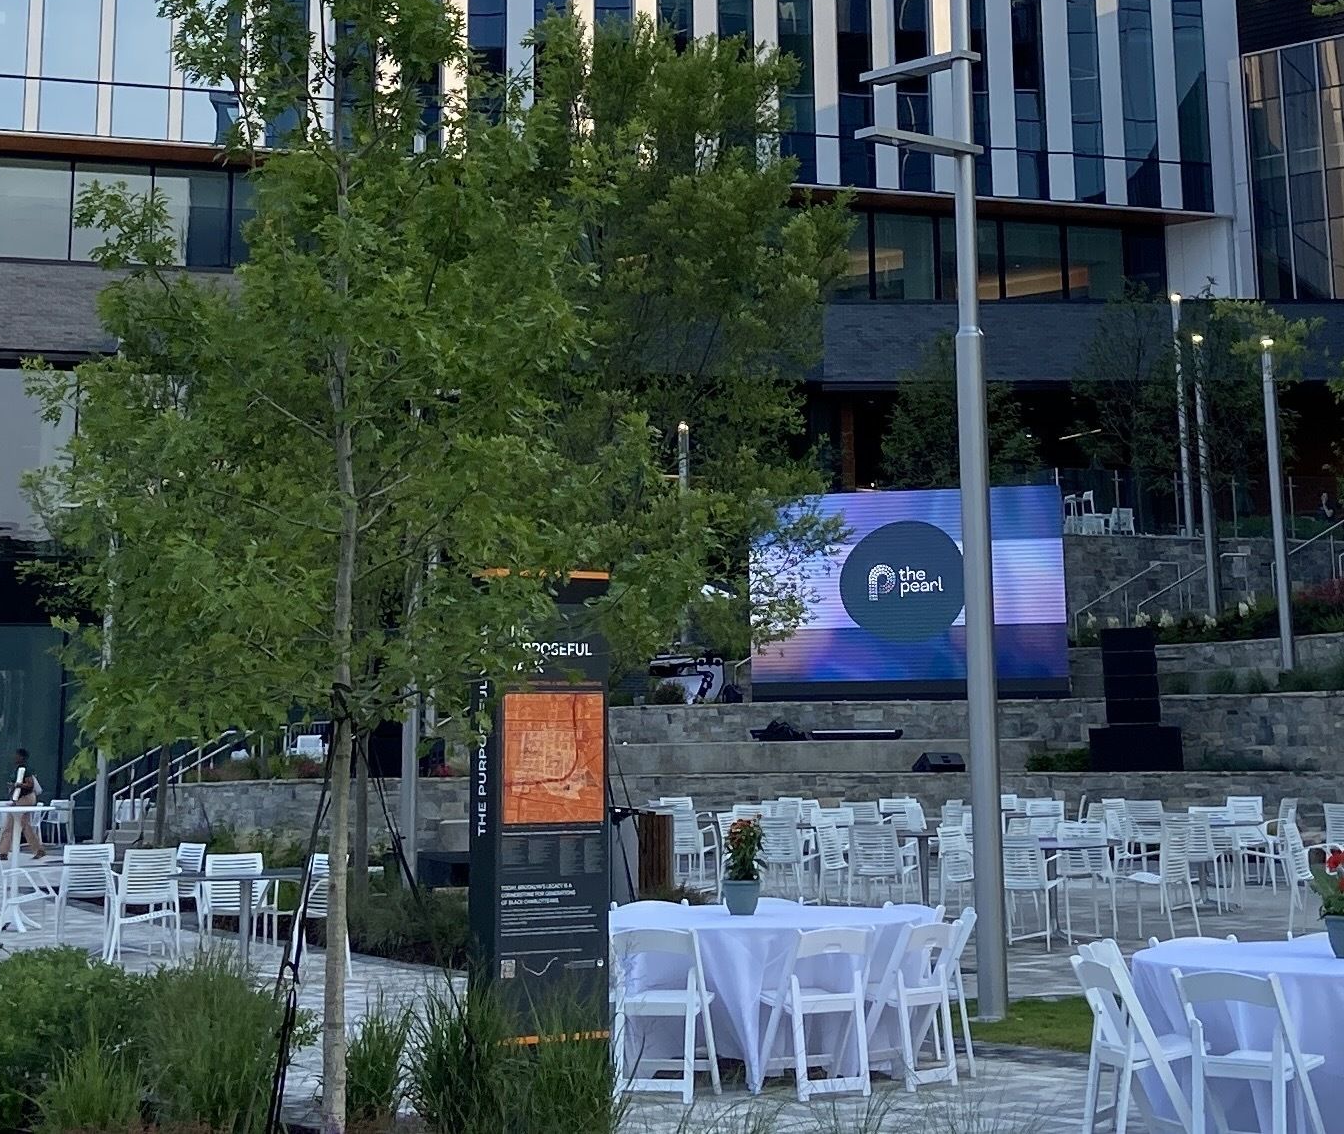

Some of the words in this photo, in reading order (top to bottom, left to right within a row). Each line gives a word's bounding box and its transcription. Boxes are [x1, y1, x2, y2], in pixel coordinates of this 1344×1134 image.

[898, 565, 926, 581] the
[900, 576, 944, 598] pearl
[477, 801, 488, 837] THE
